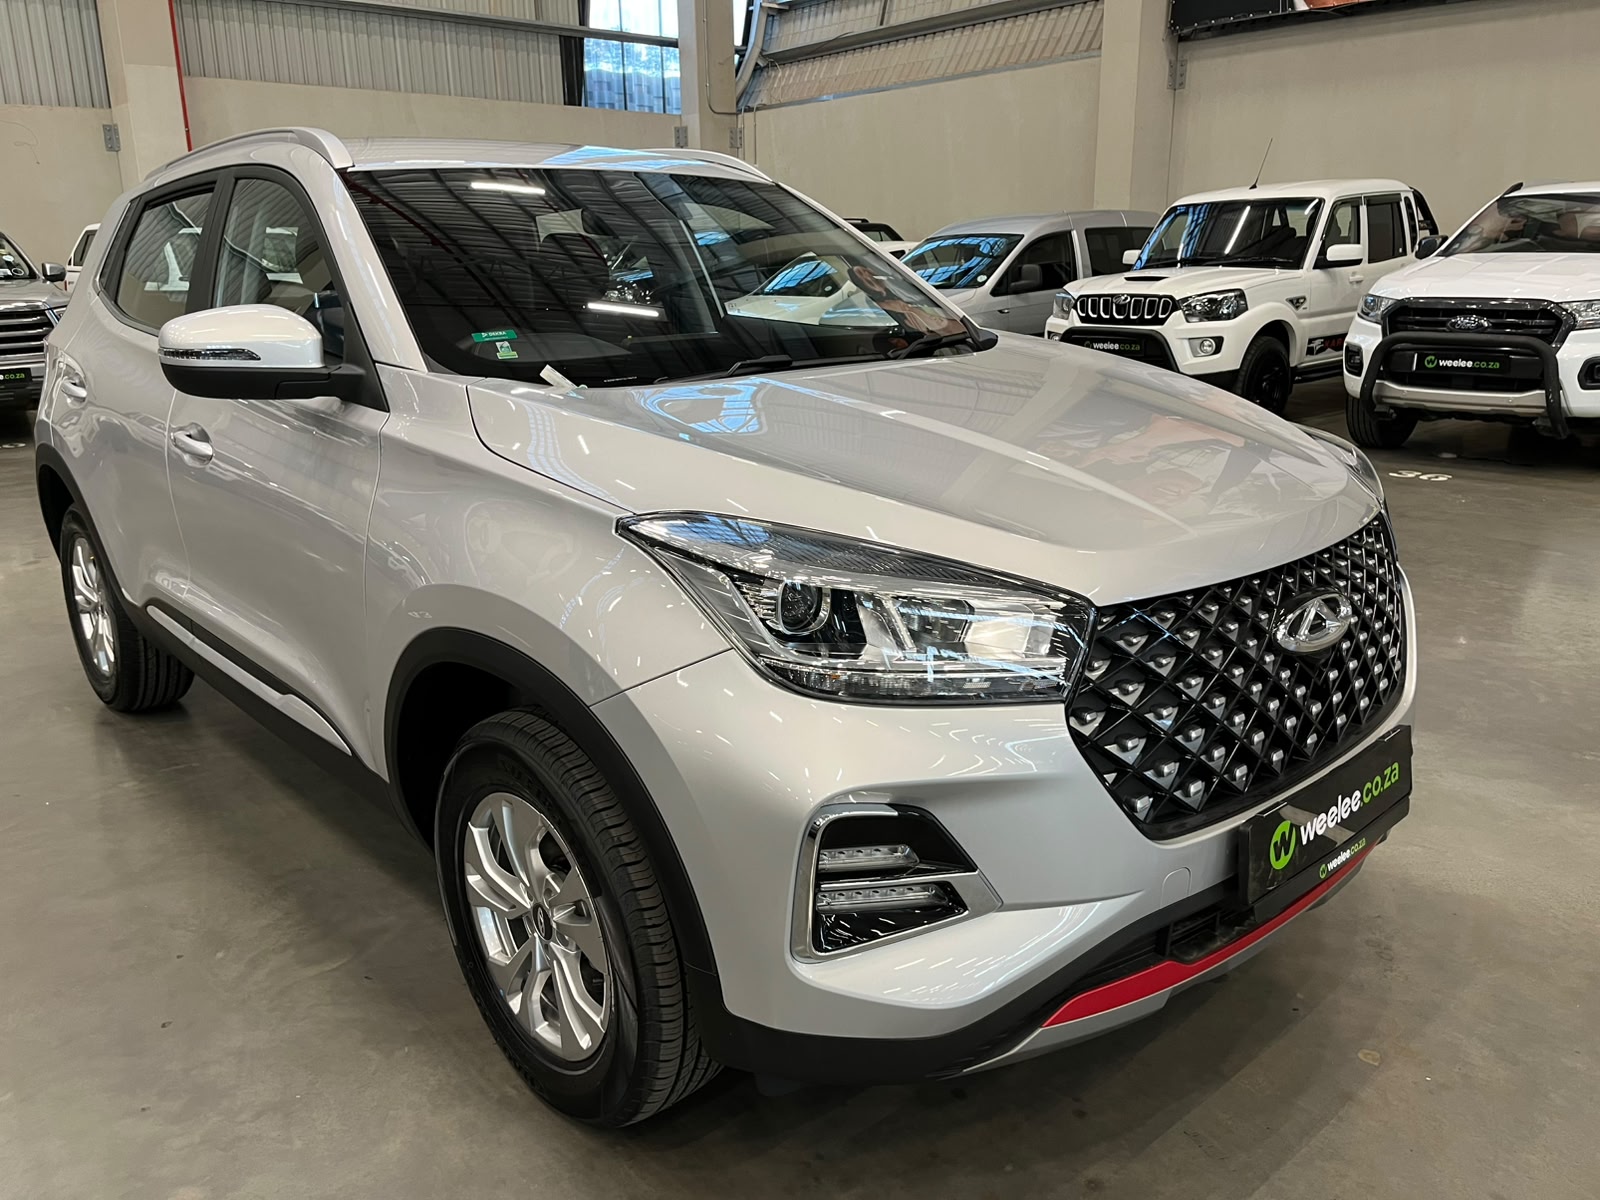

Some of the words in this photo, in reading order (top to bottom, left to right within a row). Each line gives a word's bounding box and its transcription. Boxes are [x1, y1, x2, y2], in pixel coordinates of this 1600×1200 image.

[1439, 358, 1500, 369] weelee.co.za
[1300, 762, 1399, 845] weelee.co.za
[1327, 838, 1366, 871] weelee.co.za
